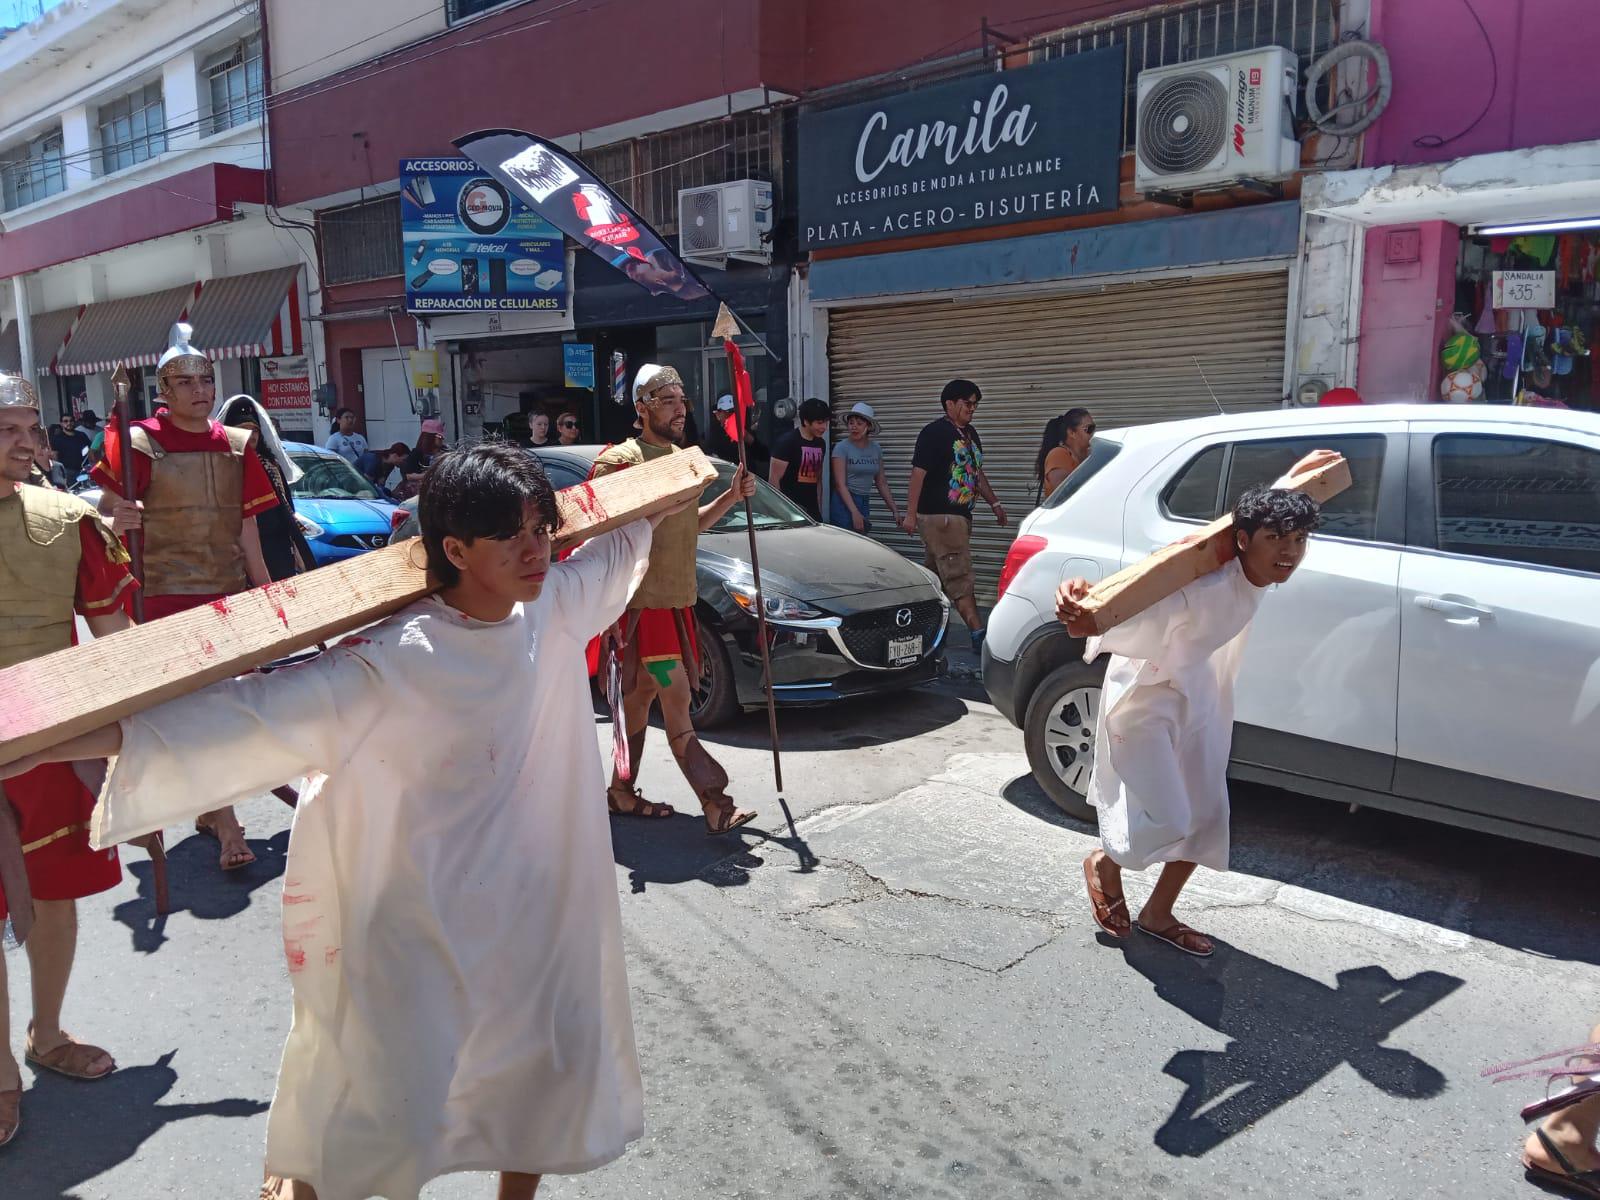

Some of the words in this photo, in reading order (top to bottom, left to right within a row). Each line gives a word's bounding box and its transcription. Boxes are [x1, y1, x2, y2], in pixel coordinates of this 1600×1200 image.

[1236, 70, 1247, 124] mirage
[1247, 87, 1256, 125] MAGNUM
[855, 83, 1037, 184] Camila
[405, 160, 474, 172] ACCESORIOS
[836, 182, 909, 207] ACCESORIOS
[912, 179, 927, 193] DE
[930, 173, 965, 191] MODA
[968, 170, 975, 184] A
[979, 168, 995, 183] TU
[1000, 157, 1063, 179] ALCANCE
[806, 221, 863, 243] PLATA
[882, 205, 955, 233] ACERO
[974, 183, 1101, 220] BISUTERÍA
[476, 243, 509, 254] telcel
[1504, 271, 1544, 281] SANDALIA
[415, 296, 482, 309] REPARACIÓN
[484, 298, 497, 309] DE
[499, 298, 558, 309] CELULARES
[279, 382, 308, 393] ESTAMOS
[268, 396, 311, 407] CONTRATANDO
